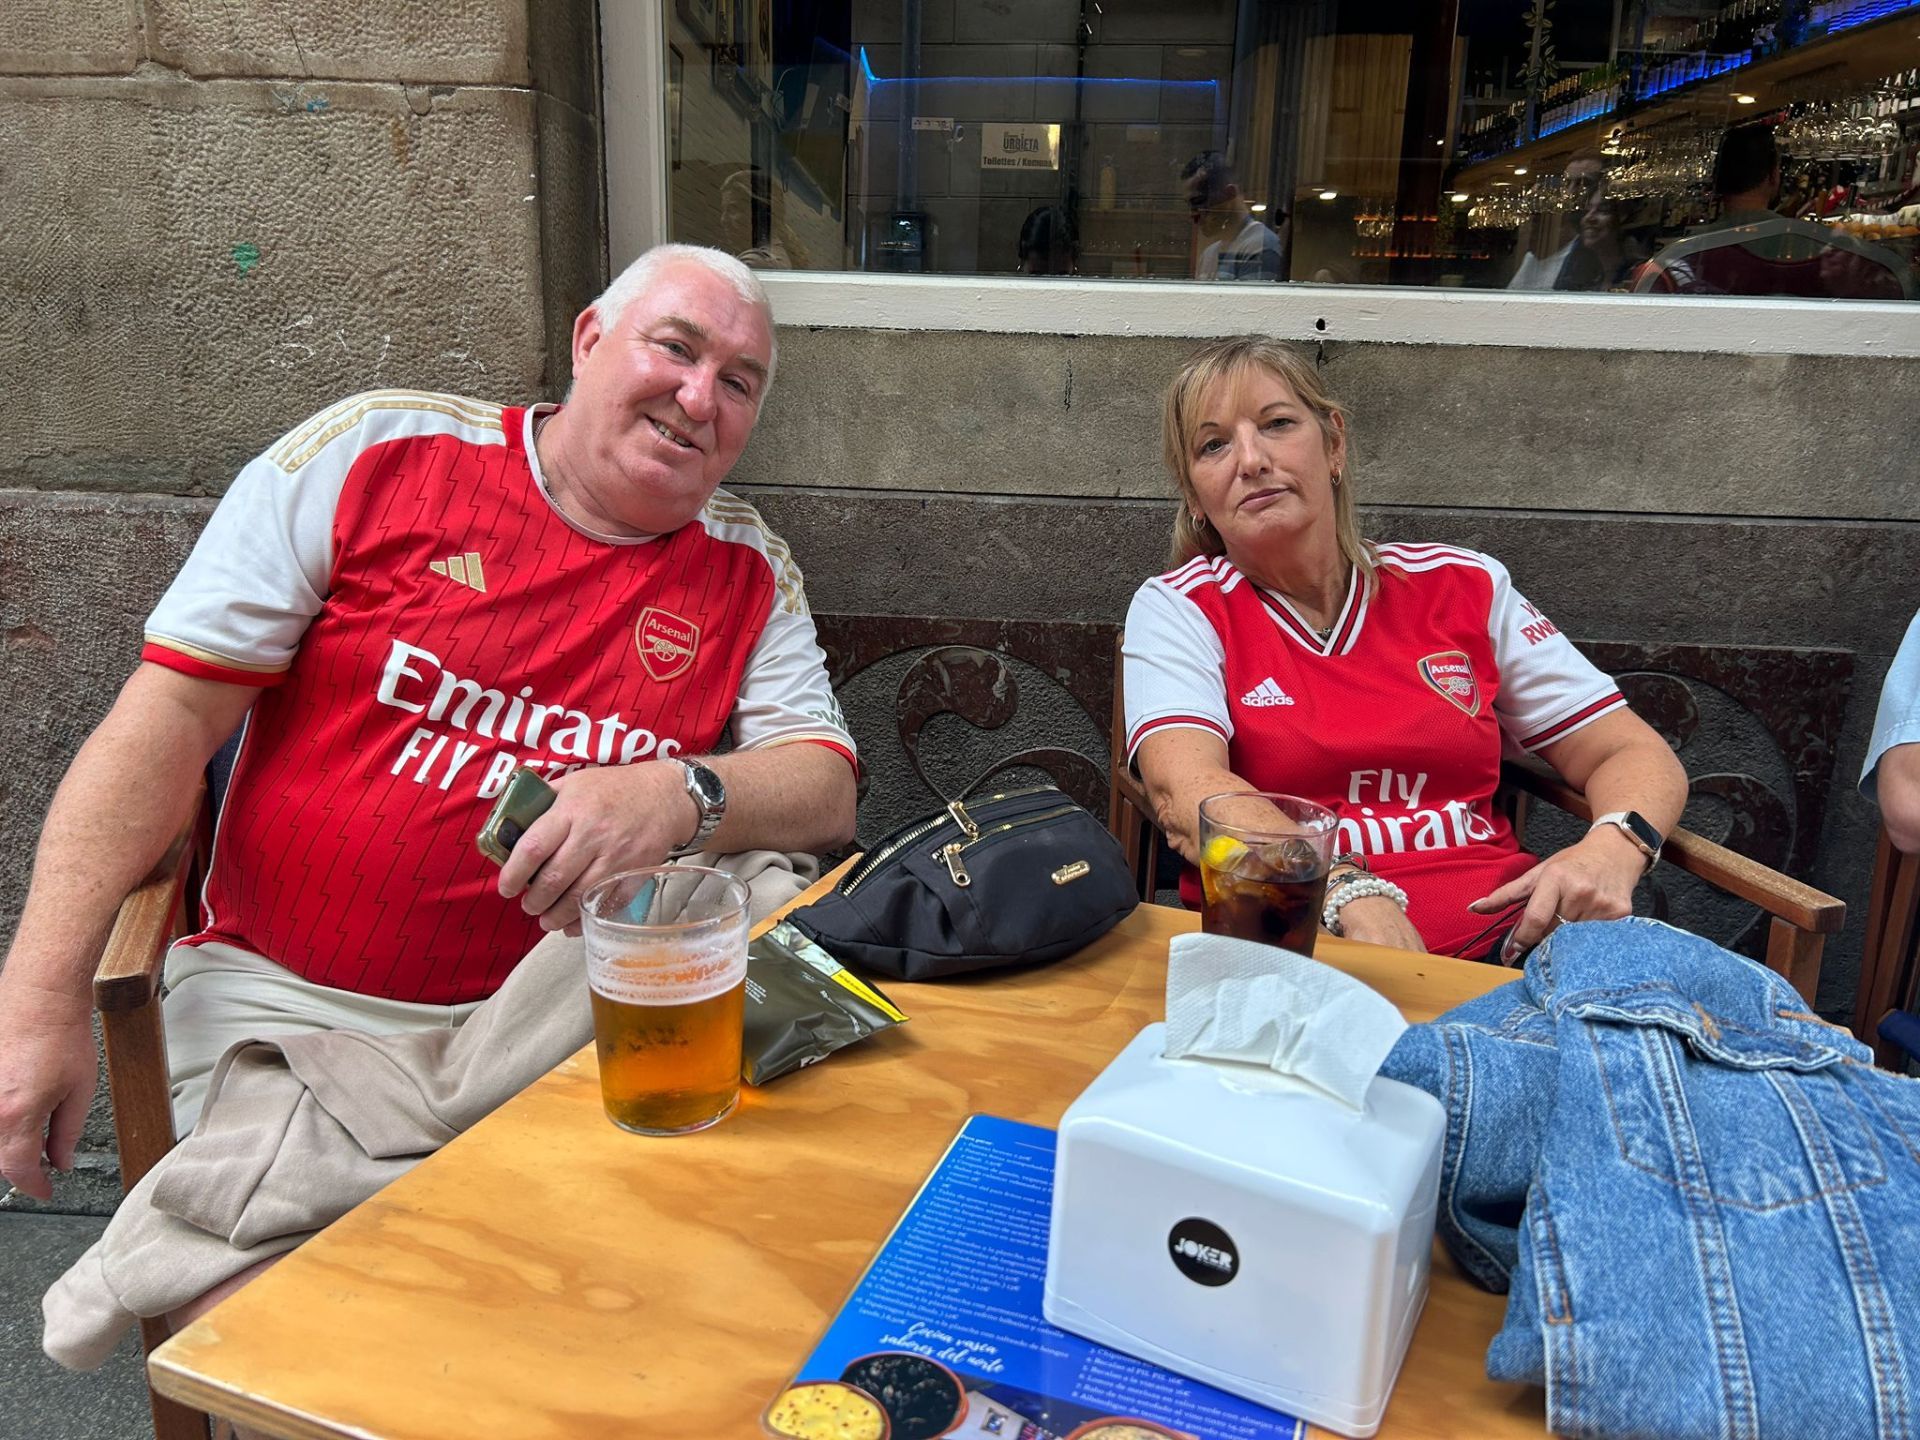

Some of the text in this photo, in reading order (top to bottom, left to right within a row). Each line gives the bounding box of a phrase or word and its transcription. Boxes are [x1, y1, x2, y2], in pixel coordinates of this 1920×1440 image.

[647, 618, 691, 643] Arsenal
[1431, 664, 1471, 675] Arsenal
[391, 728, 480, 791] FLY
[1348, 768, 1427, 809] Fly
[1174, 1237, 1233, 1268] JOKER
[879, 1332, 1005, 1373] sabores del norte
[908, 1321, 998, 1355] Cocina vasca
